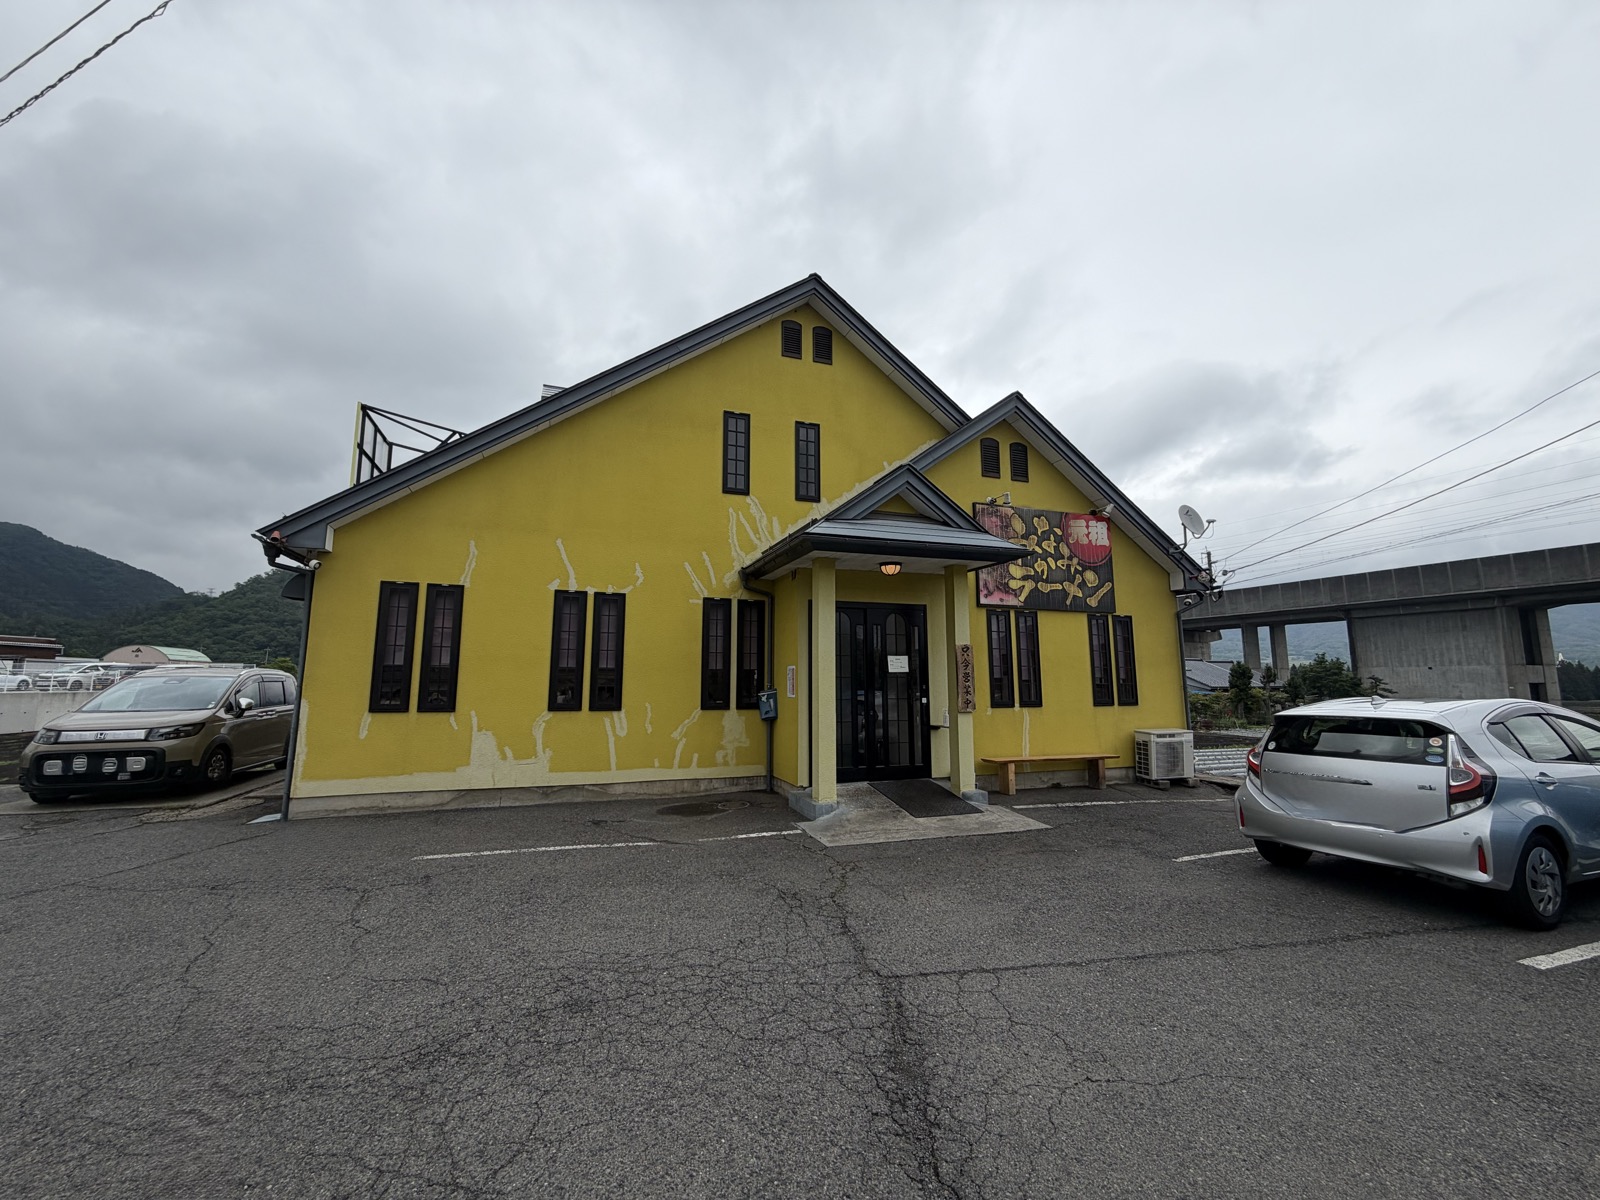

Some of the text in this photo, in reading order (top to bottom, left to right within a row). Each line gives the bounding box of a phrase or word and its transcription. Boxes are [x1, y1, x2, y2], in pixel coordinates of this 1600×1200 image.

[1068, 519, 1110, 547] 元祖
[1008, 563, 1112, 608] ラーメン
